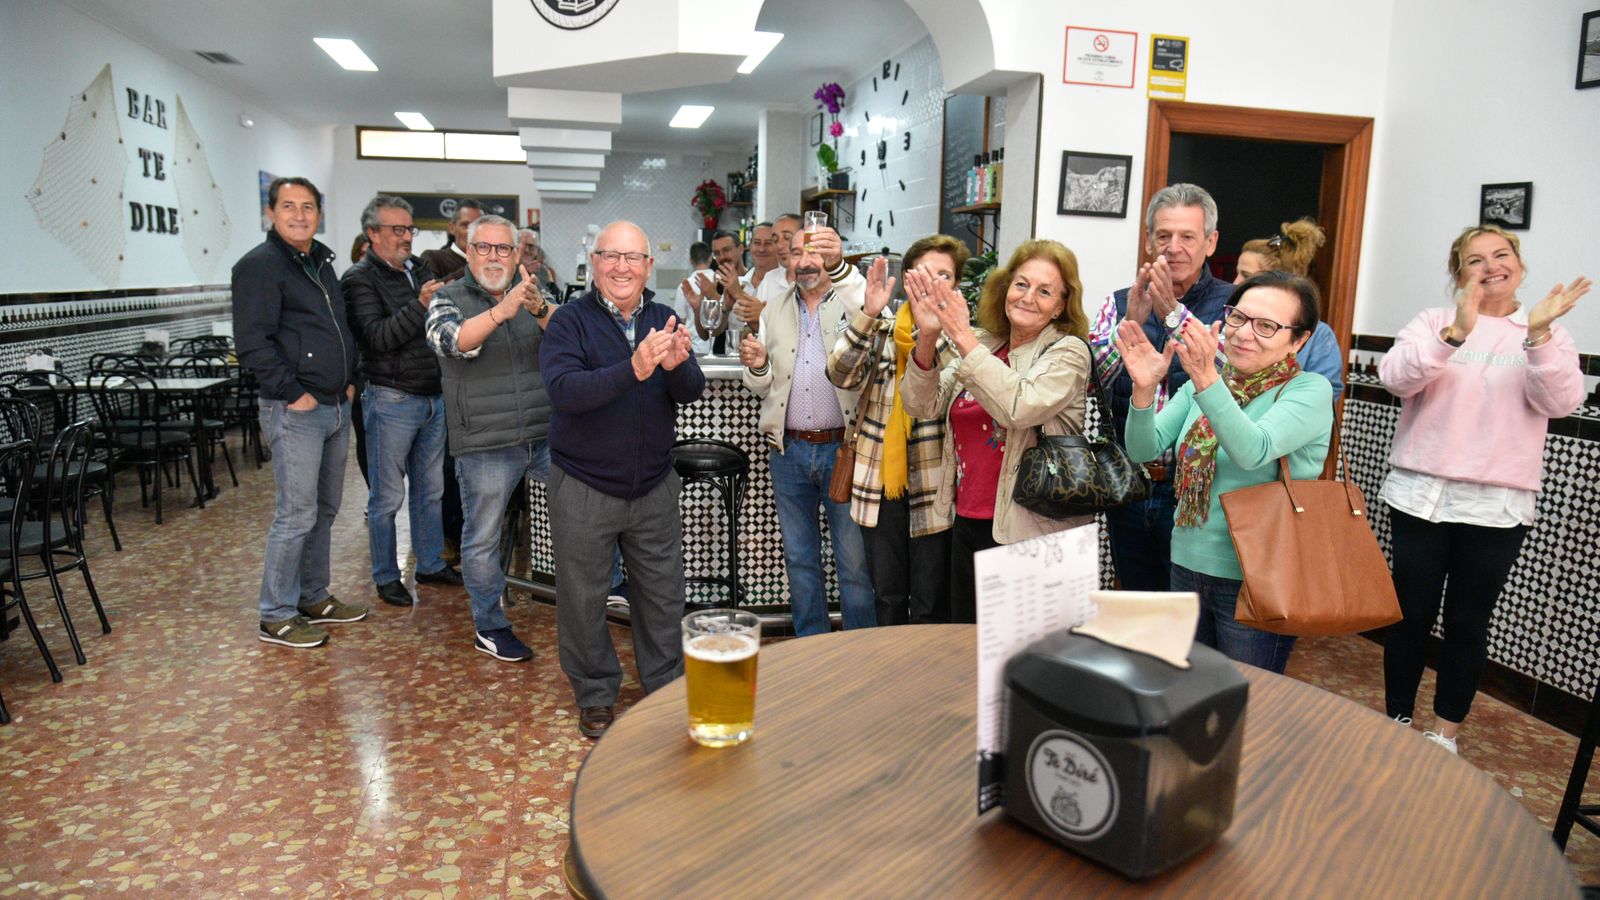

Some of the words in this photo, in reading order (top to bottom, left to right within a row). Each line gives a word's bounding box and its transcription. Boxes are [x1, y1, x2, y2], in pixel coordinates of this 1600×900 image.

[126, 87, 168, 130] BAR
[903, 131, 911, 151] 3
[138, 147, 166, 182] TE
[861, 150, 866, 166] 9
[129, 201, 180, 236] DIRE
[876, 220, 883, 238] 6
[1043, 747, 1061, 769] Te
